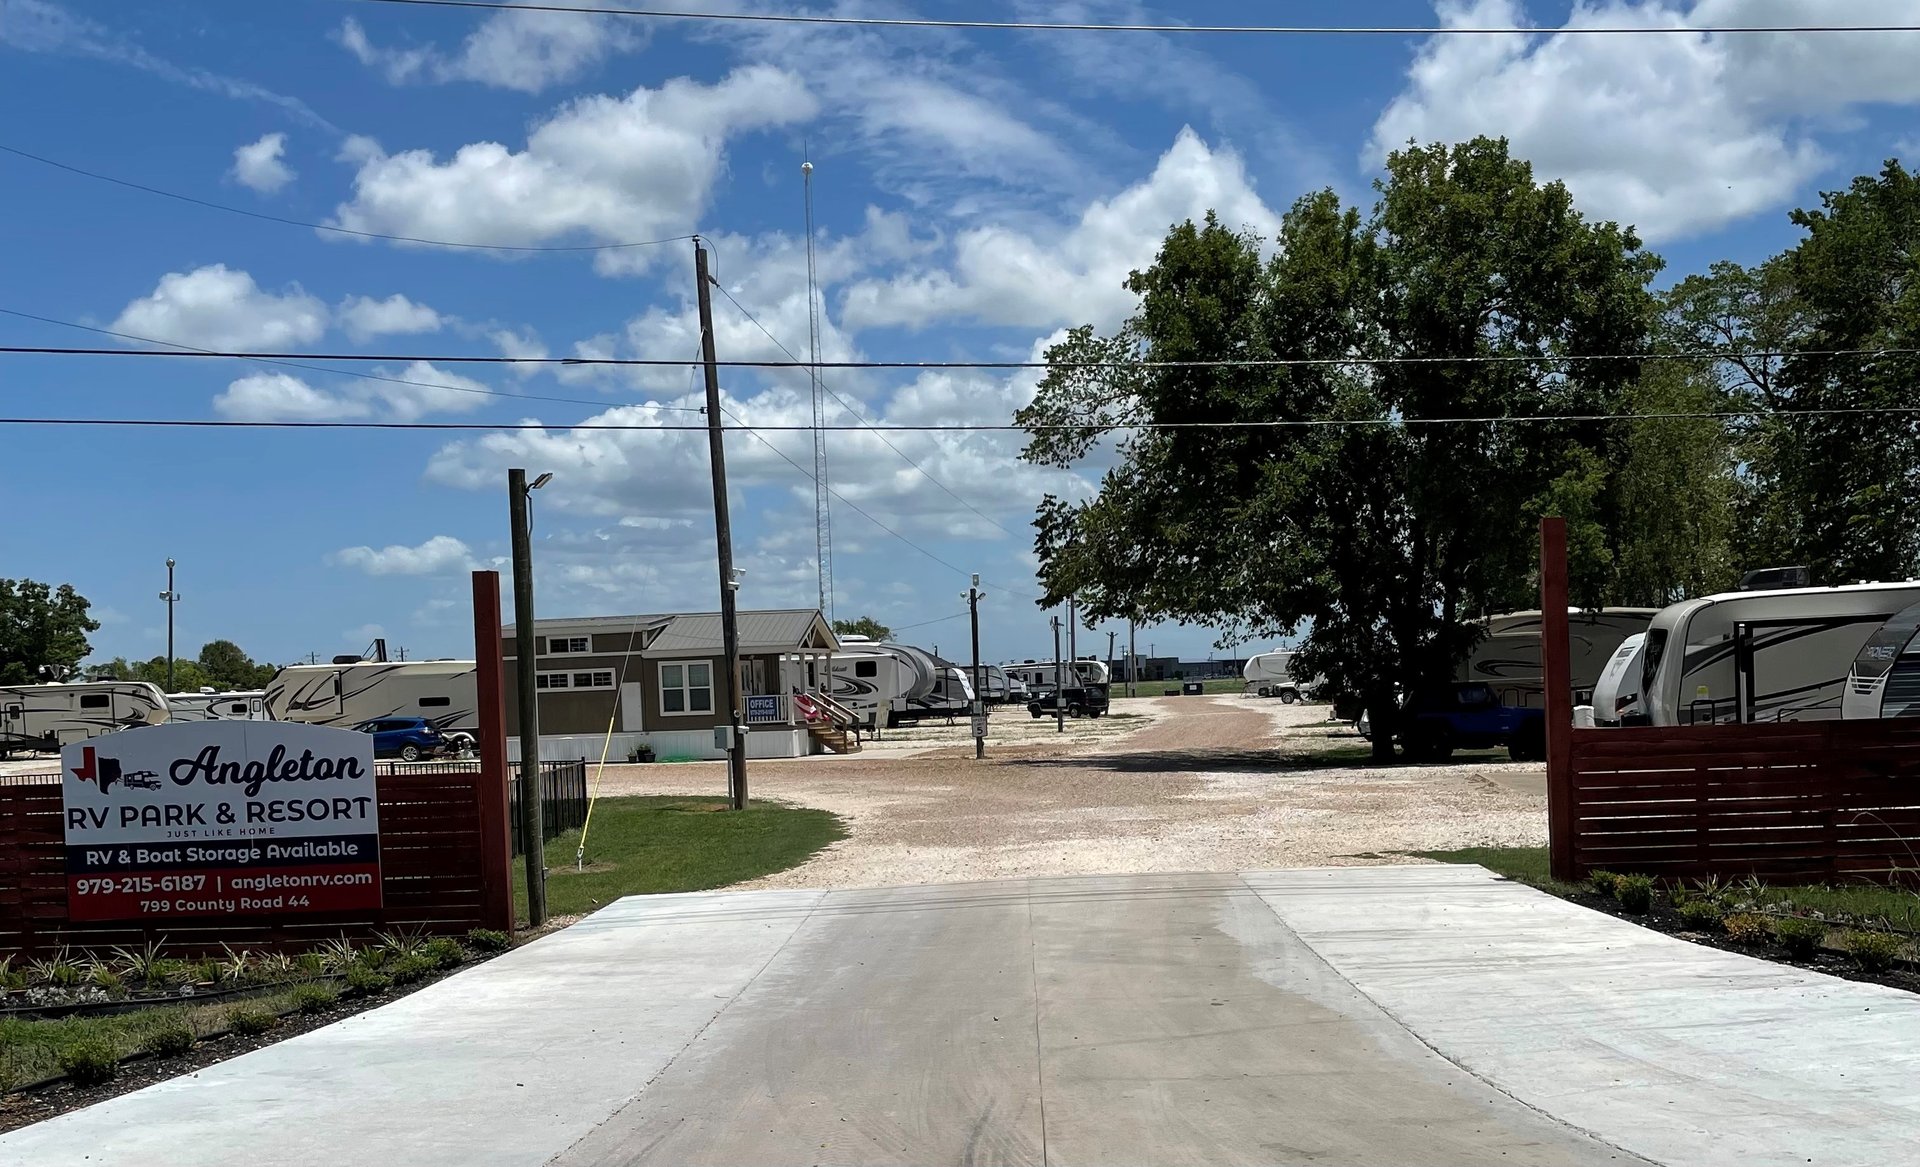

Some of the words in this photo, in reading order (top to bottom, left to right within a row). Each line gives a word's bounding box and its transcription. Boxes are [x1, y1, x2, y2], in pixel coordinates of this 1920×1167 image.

[750, 699, 774, 709] OFFICE
[976, 726, 984, 735] 5
[169, 744, 365, 797] Angleton
[67, 807, 110, 830] RV
[120, 803, 207, 828] PARK
[215, 802, 236, 824] &
[246, 796, 372, 824] RESORT
[167, 830, 197, 838] JUST
[204, 829, 232, 837] LIKE
[239, 827, 275, 836] HOME
[86, 850, 113, 865] RV
[118, 849, 131, 864] &
[137, 848, 182, 864] Boat
[186, 847, 261, 864] Storage
[267, 841, 359, 859] Available
[76, 875, 206, 895] 979-215-6187
[231, 873, 372, 892] angletonrv.com
[140, 900, 170, 913] 799
[175, 899, 236, 913] County
[240, 896, 283, 909] Road
[288, 895, 310, 907] 44
